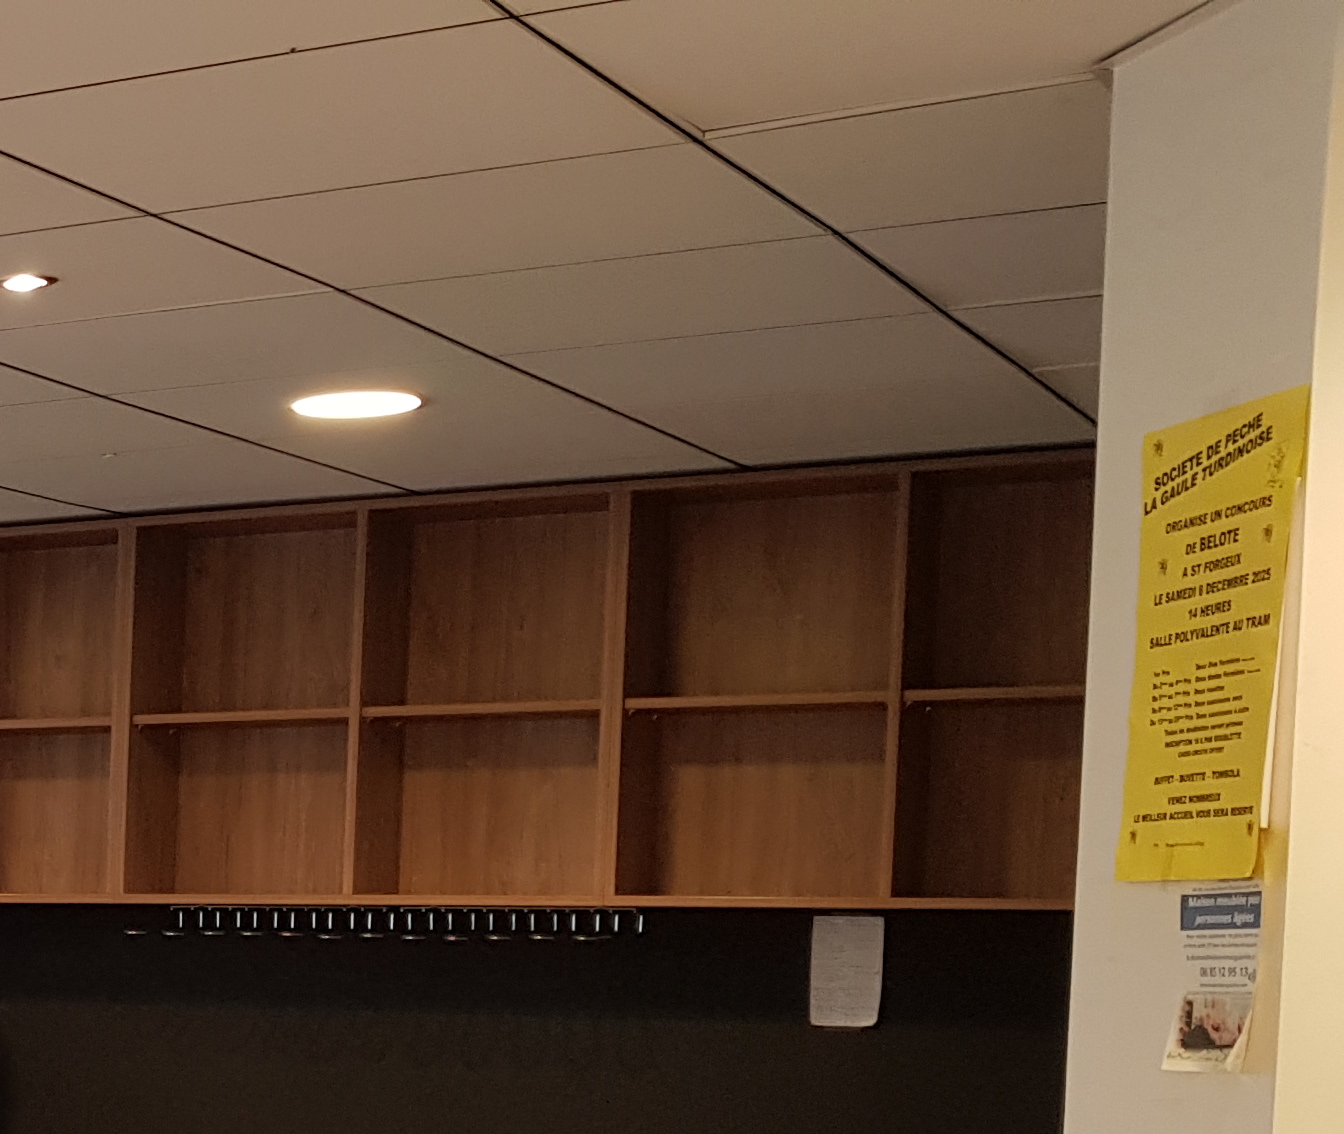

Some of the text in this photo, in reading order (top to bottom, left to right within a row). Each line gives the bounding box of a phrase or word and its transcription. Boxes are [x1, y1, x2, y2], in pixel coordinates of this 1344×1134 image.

[1154, 412, 1263, 491] SOCIETE DE PECHE
[1144, 425, 1273, 516] LA GAULE TURDINOISE
[1165, 495, 1273, 534] ORGANISE UN CONCOURS
[1185, 527, 1240, 555] DE BELOTE
[1182, 552, 1242, 578] A ST FORGEUX
[1154, 594, 1163, 606] LE
[1165, 586, 1196, 604] SAMEDI
[1206, 573, 1249, 594] DECEMBRE
[1188, 600, 1232, 620] 14 HEURES
[1149, 613, 1271, 649] SALLE POLYVALENTE AU TRAM
